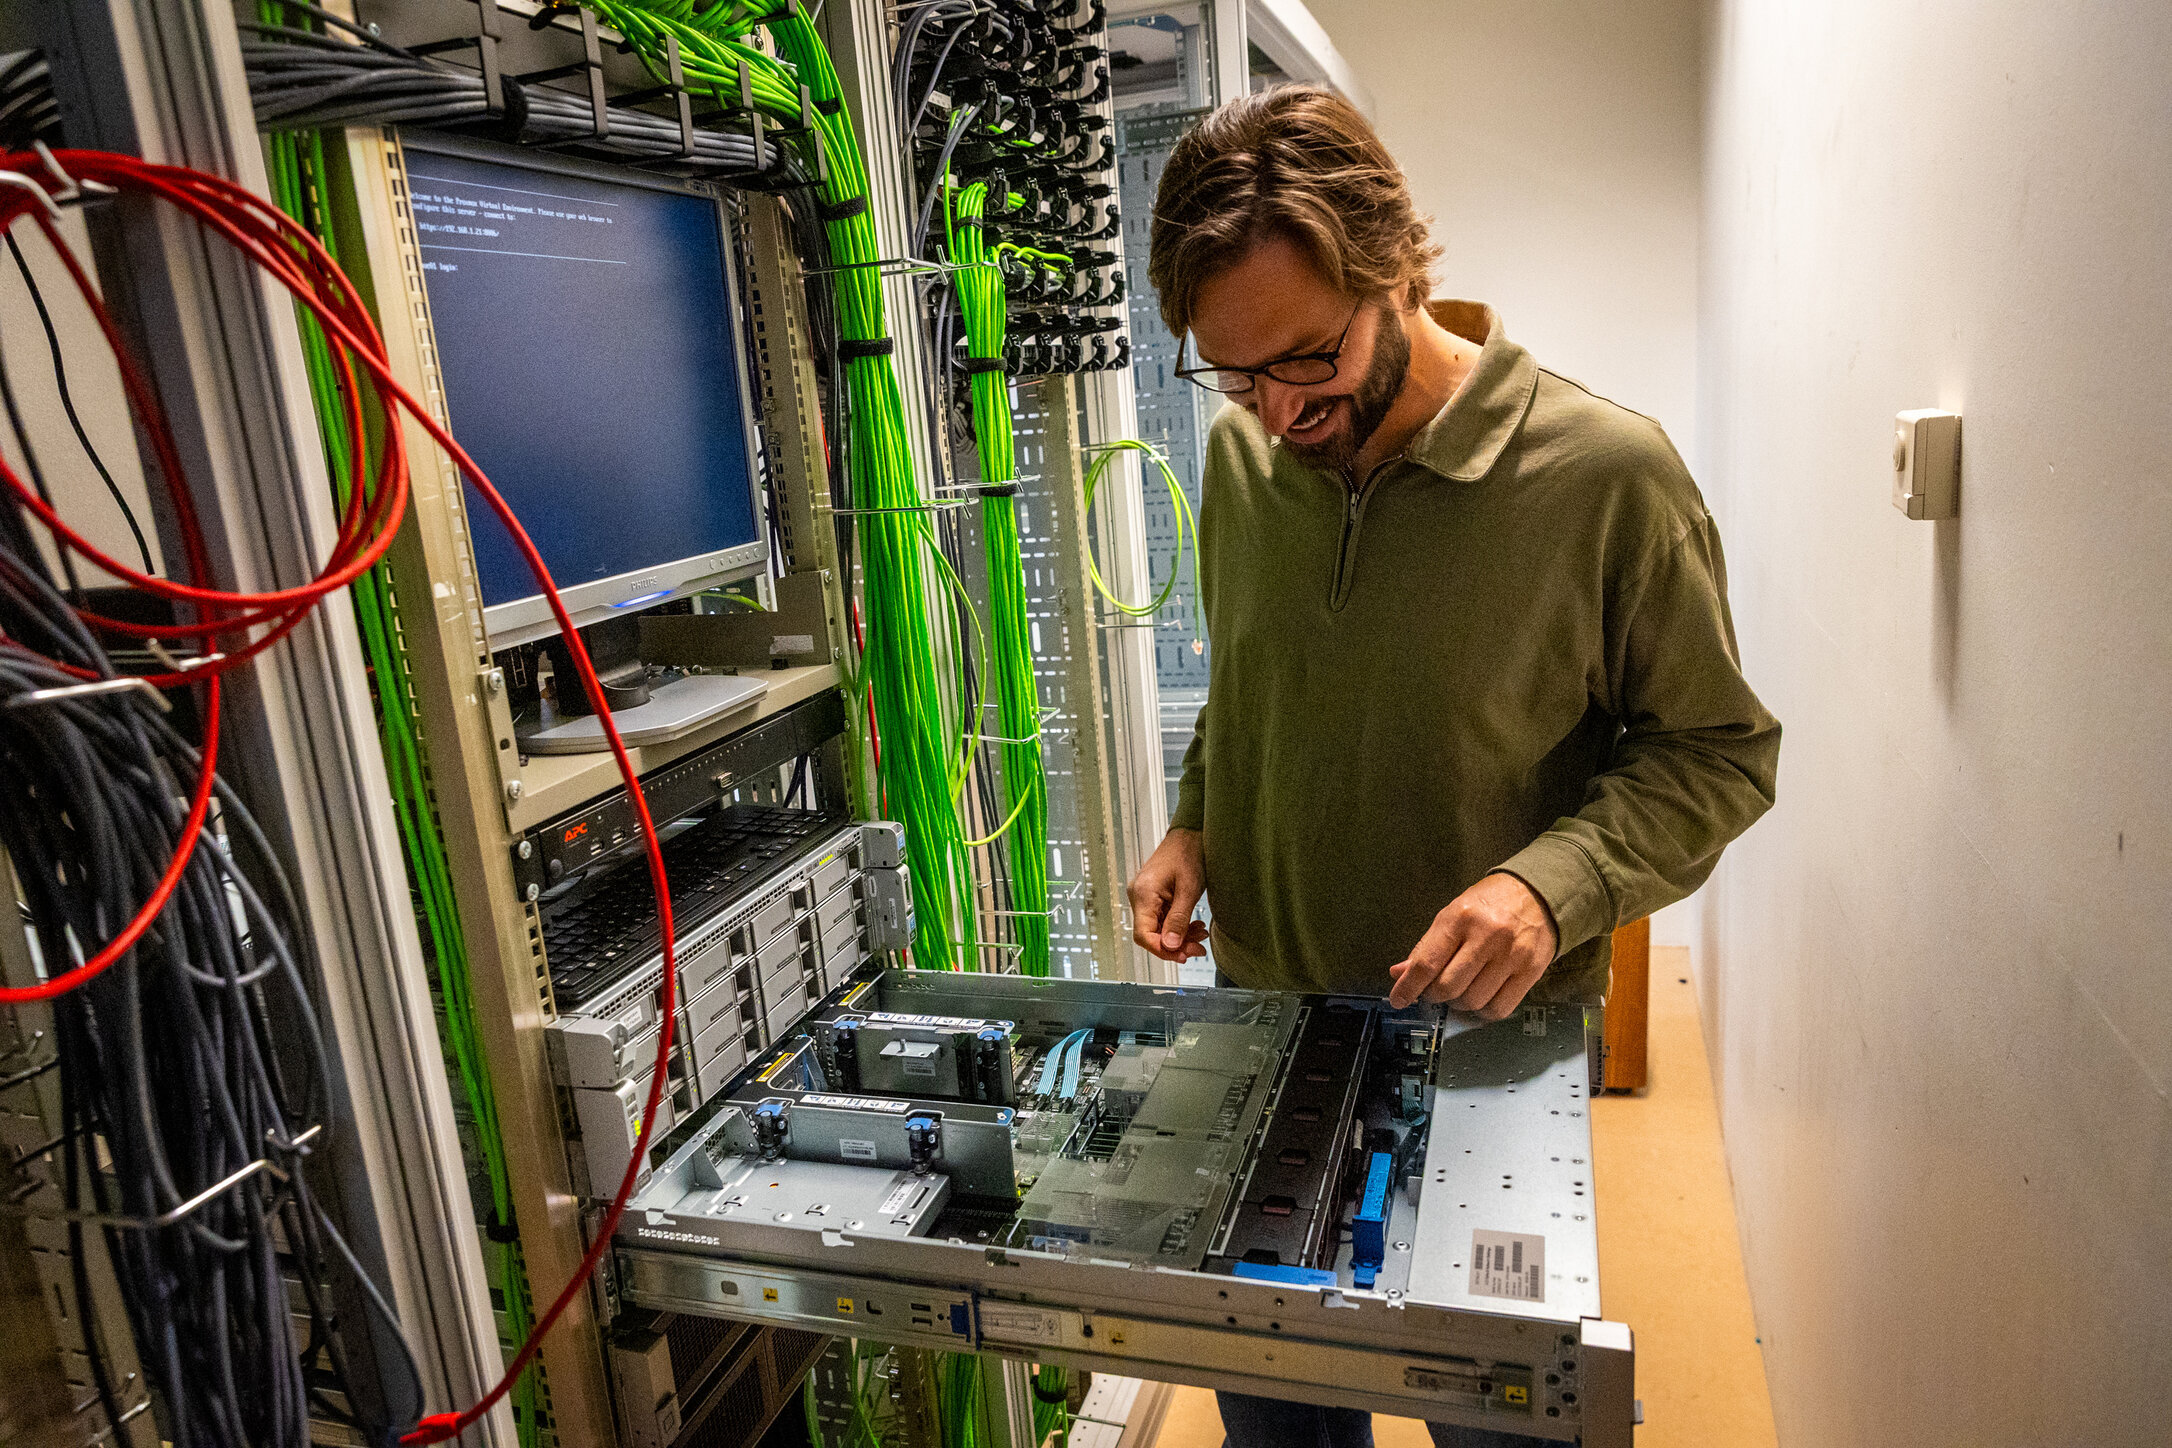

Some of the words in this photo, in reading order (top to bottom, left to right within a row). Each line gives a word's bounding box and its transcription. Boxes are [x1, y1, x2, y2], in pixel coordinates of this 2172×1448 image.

[410, 192, 432, 201] elcome
[433, 195, 442, 203] to
[443, 196, 454, 204] the
[479, 200, 501, 210] Virtual
[537, 207, 555, 217] Please
[578, 213, 587, 221] web
[441, 205, 456, 214] this
[457, 208, 477, 216] server
[483, 211, 506, 220] connect
[439, 262, 458, 272] login:
[630, 576, 658, 591] PHILIPS
[564, 822, 588, 843] APC
